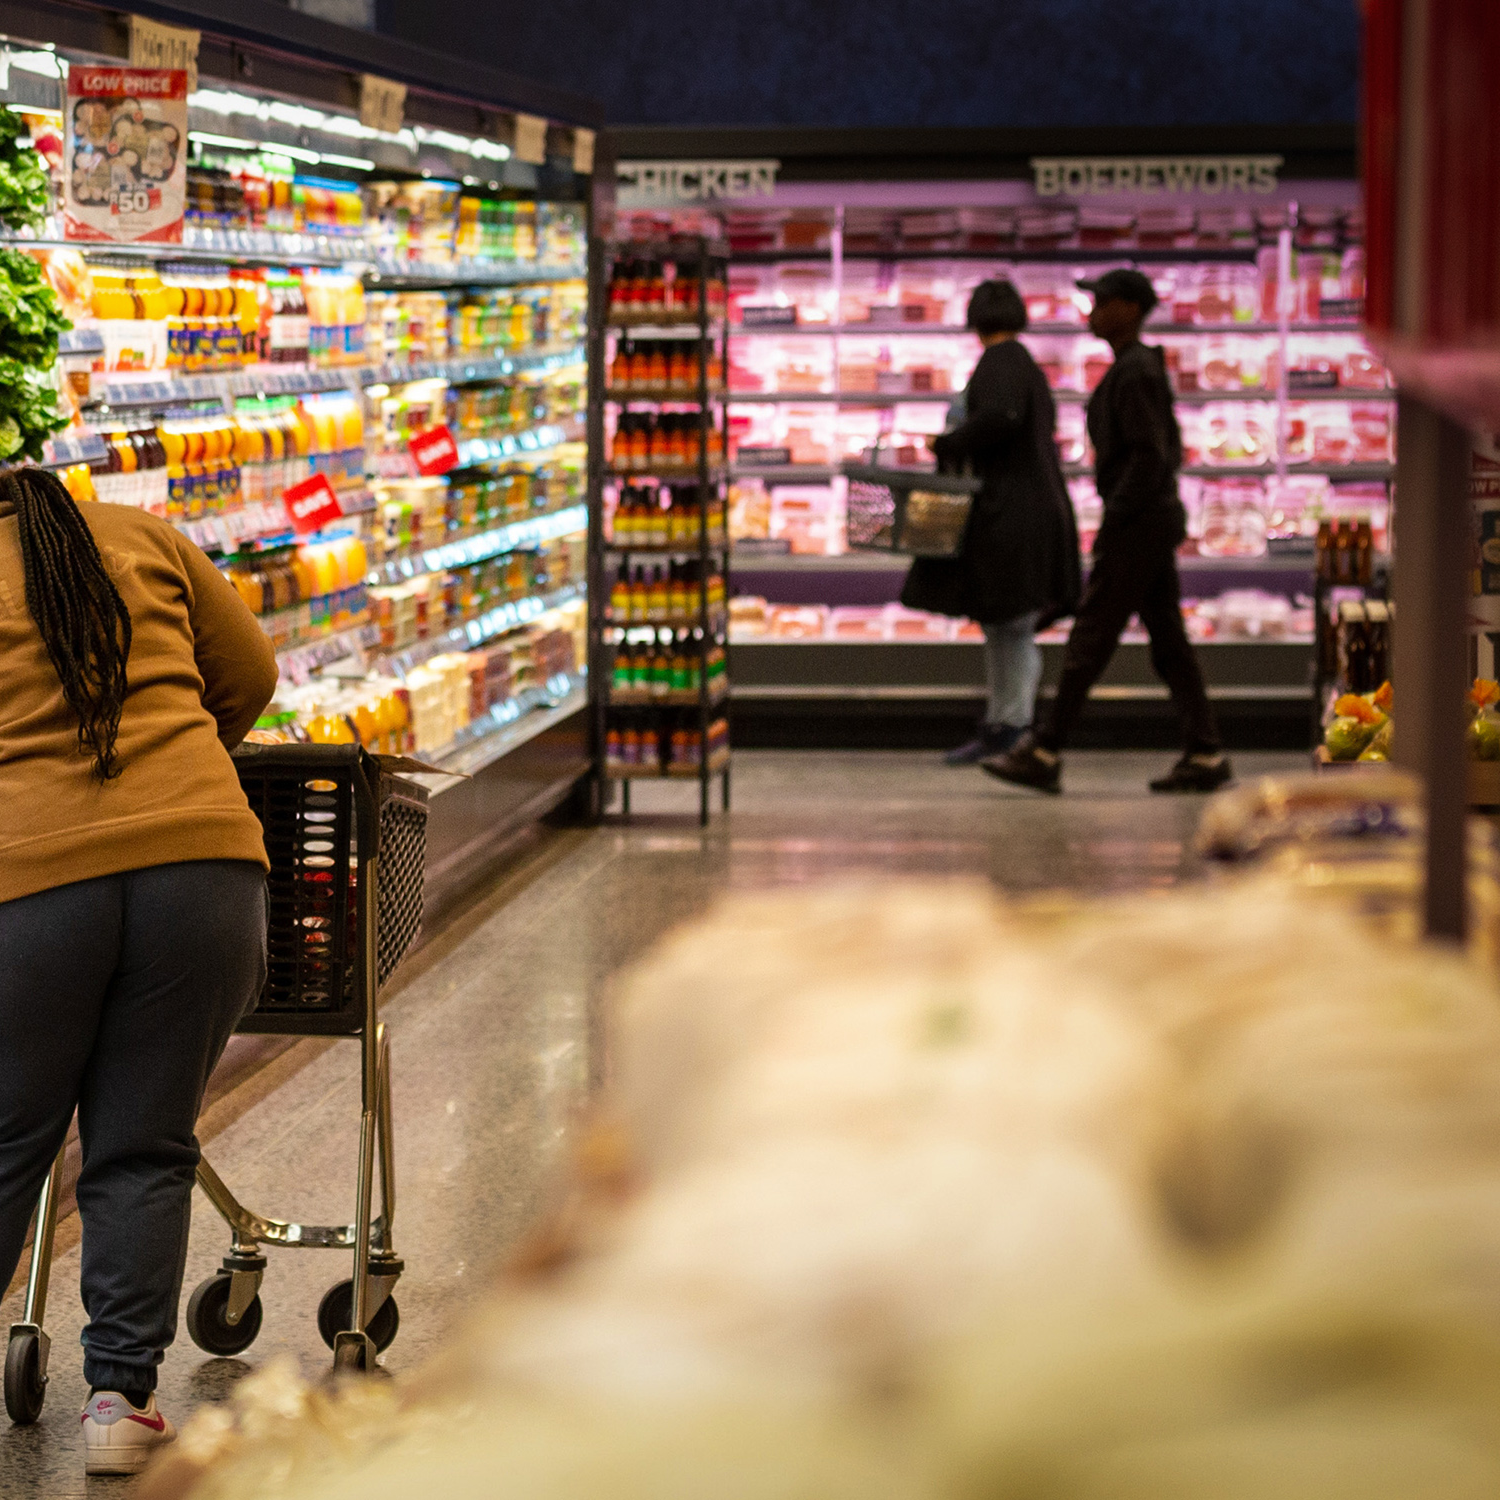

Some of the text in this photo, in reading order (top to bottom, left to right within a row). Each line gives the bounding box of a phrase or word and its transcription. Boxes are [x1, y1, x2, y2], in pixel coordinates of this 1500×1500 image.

[82, 75, 170, 92] LOW PRICE
[1033, 156, 1280, 195] BOEREWORS
